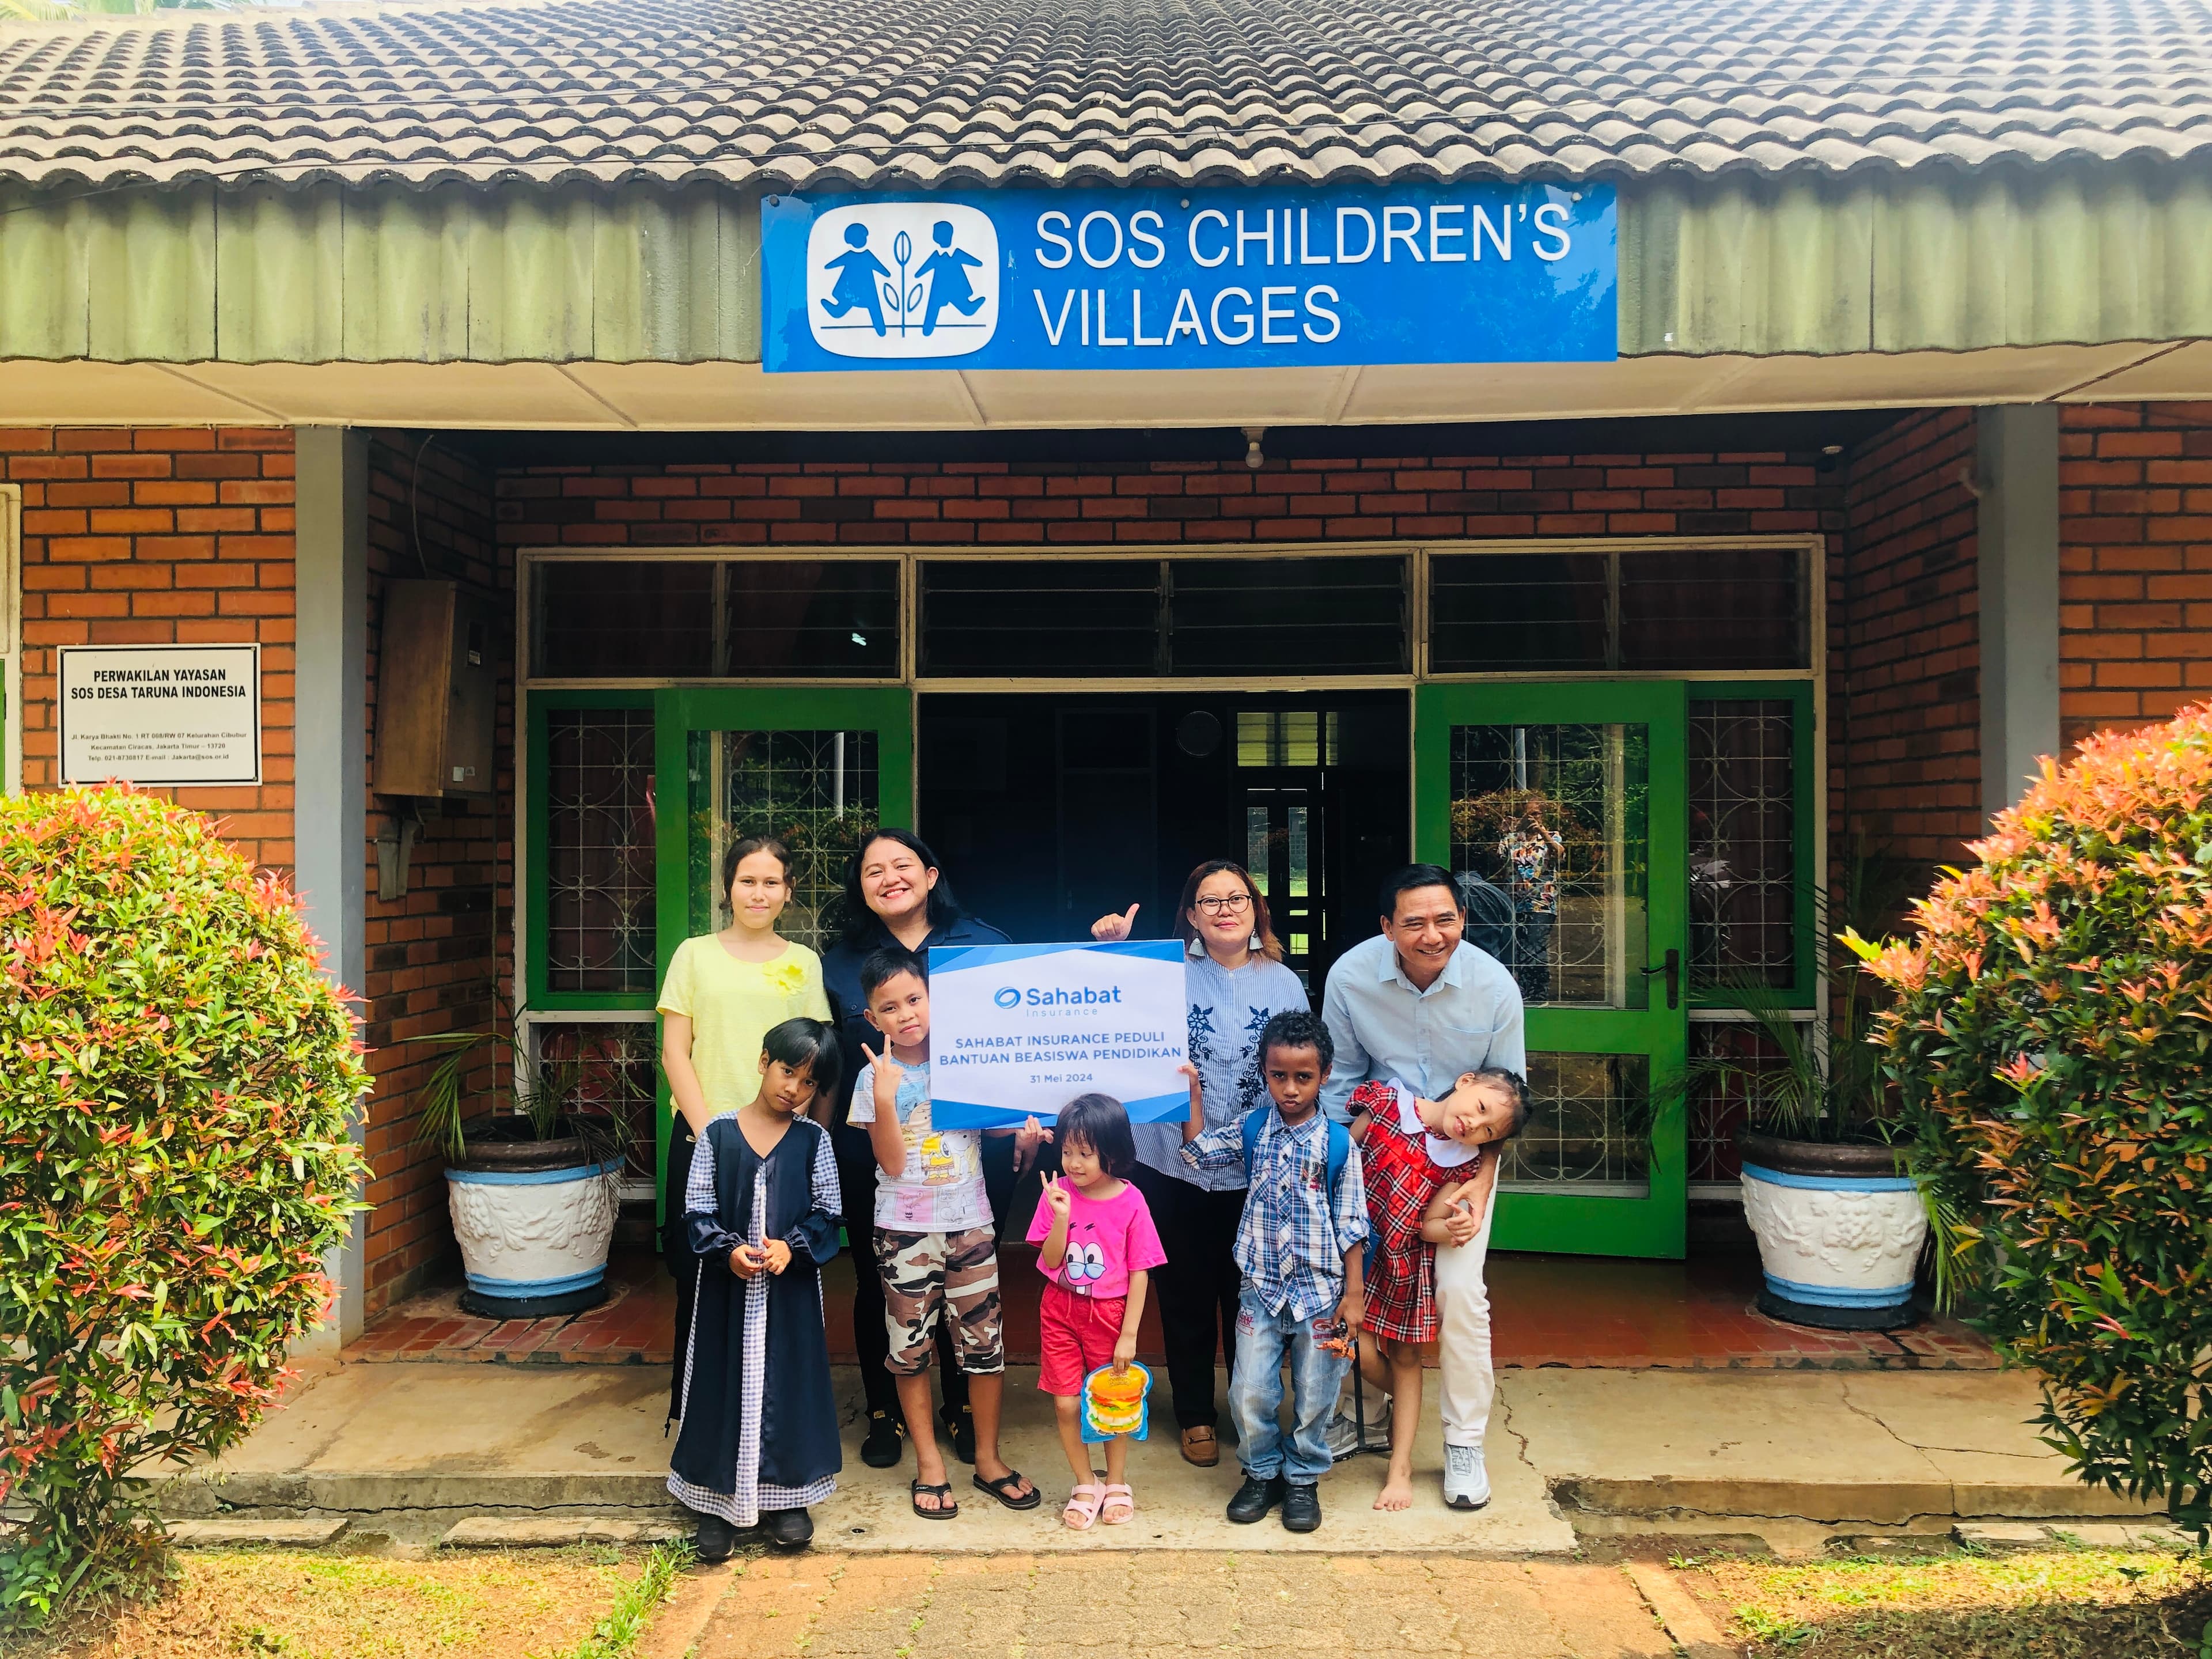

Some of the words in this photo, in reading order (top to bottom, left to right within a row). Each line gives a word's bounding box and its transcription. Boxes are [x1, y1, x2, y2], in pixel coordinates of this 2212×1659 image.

[1035, 210, 1165, 269] SOS
[1187, 203, 1573, 267] CHILDREN'S
[1033, 285, 1341, 347] VILLAGES
[94, 669, 169, 682] PERWAKILAN
[173, 669, 226, 681] YAYASAN
[71, 687, 94, 699] SOS
[97, 687, 128, 699] DESA
[131, 686, 178, 698] TARUNA
[182, 685, 246, 698] INDONESIA
[1027, 986, 1122, 1006] Sahabat
[1027, 1008, 1098, 1017] Insurance
[956, 1036, 1022, 1049] SAHABAT
[1028, 1033, 1109, 1046] INSURANCE
[1115, 1032, 1164, 1043] PEDULI
[940, 1053, 1009, 1066] BANTUAN
[1015, 1050, 1089, 1062] BEASISWA
[1093, 1047, 1181, 1060] PENDIDIKAN
[1030, 1075, 1040, 1084] 31
[1044, 1074, 1063, 1083] Mei
[1066, 1073, 1093, 1082] 2024
